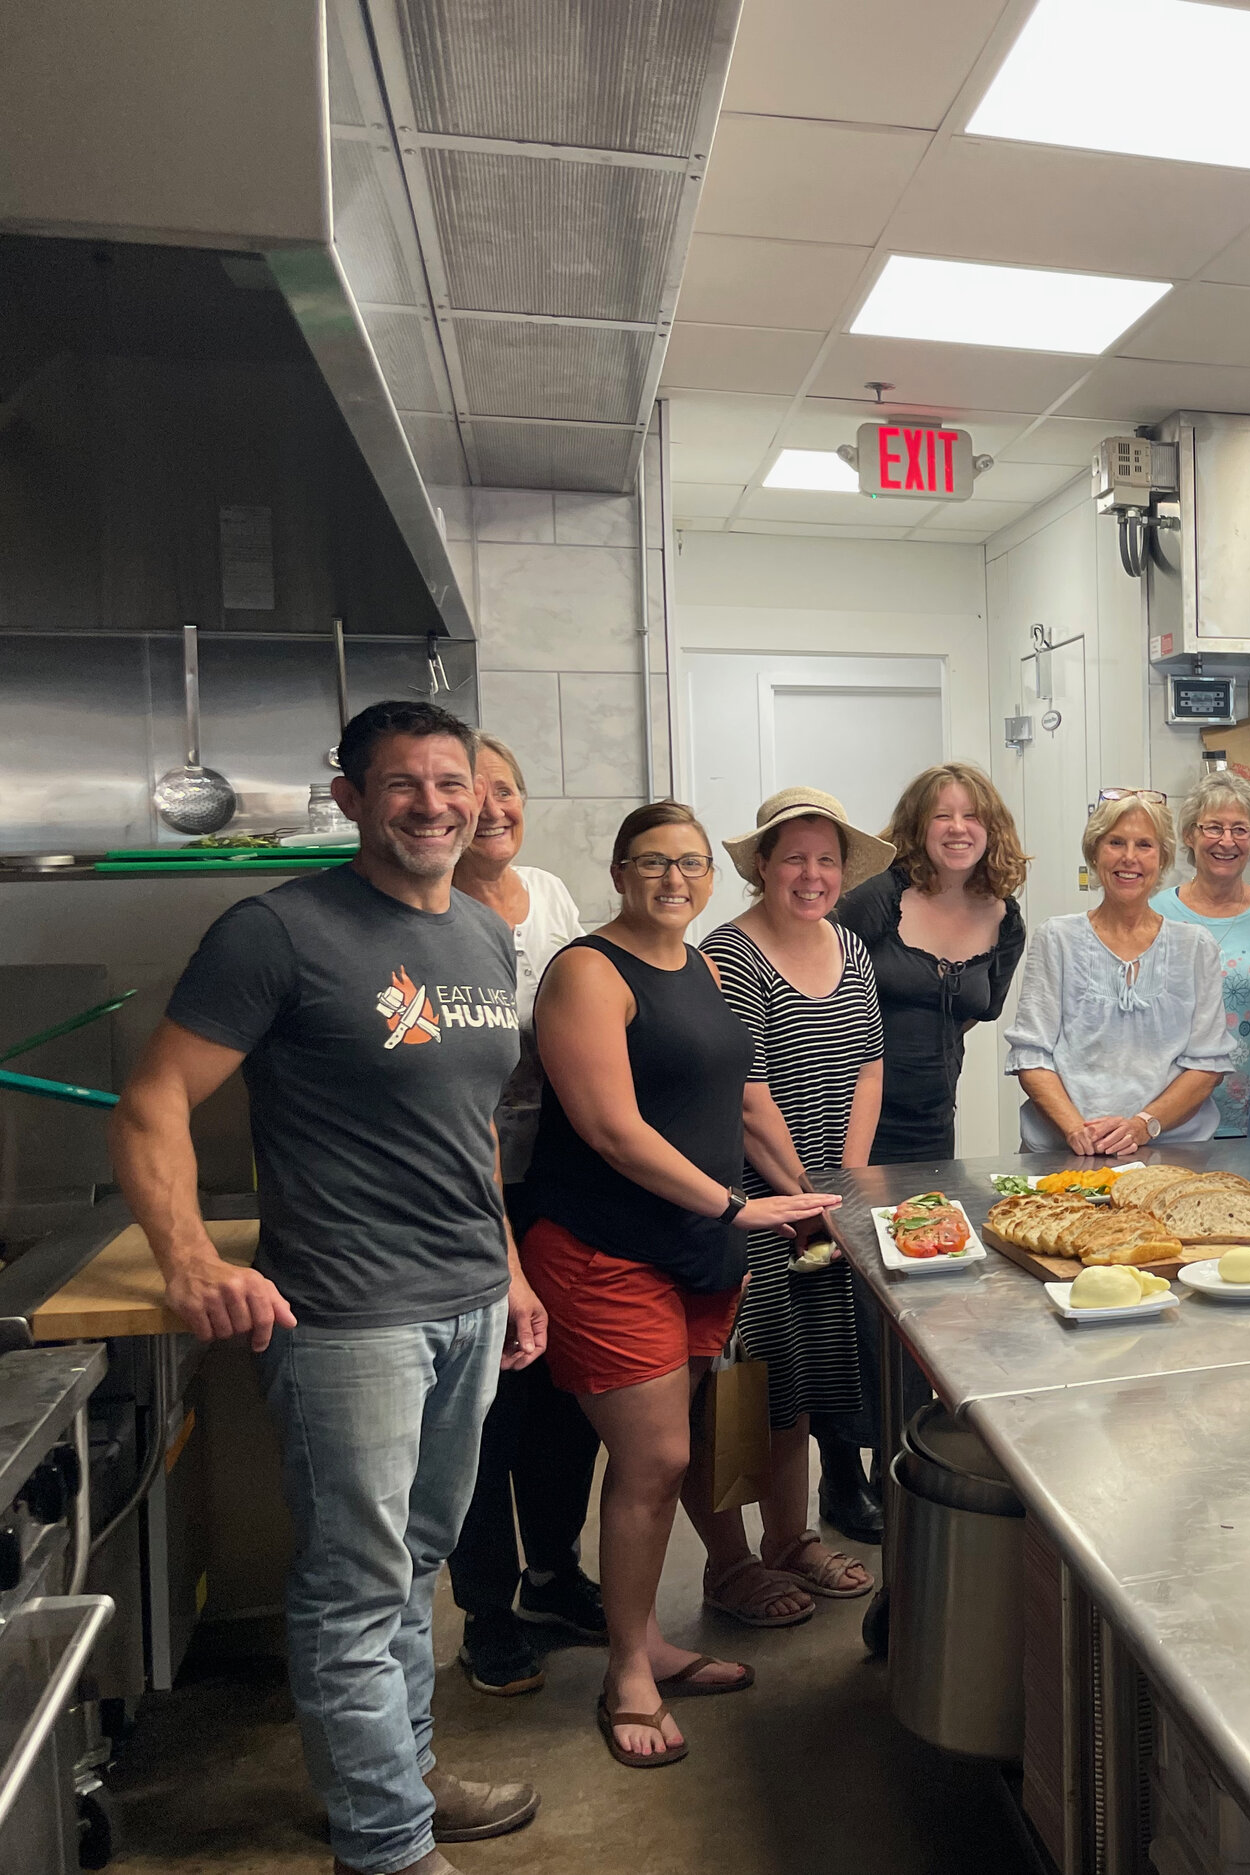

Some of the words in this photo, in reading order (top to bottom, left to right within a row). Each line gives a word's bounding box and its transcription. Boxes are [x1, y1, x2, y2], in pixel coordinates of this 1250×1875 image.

[878, 426, 958, 493] EXIT
[436, 985, 473, 1004] EAT
[478, 987, 511, 1007] LIKE
